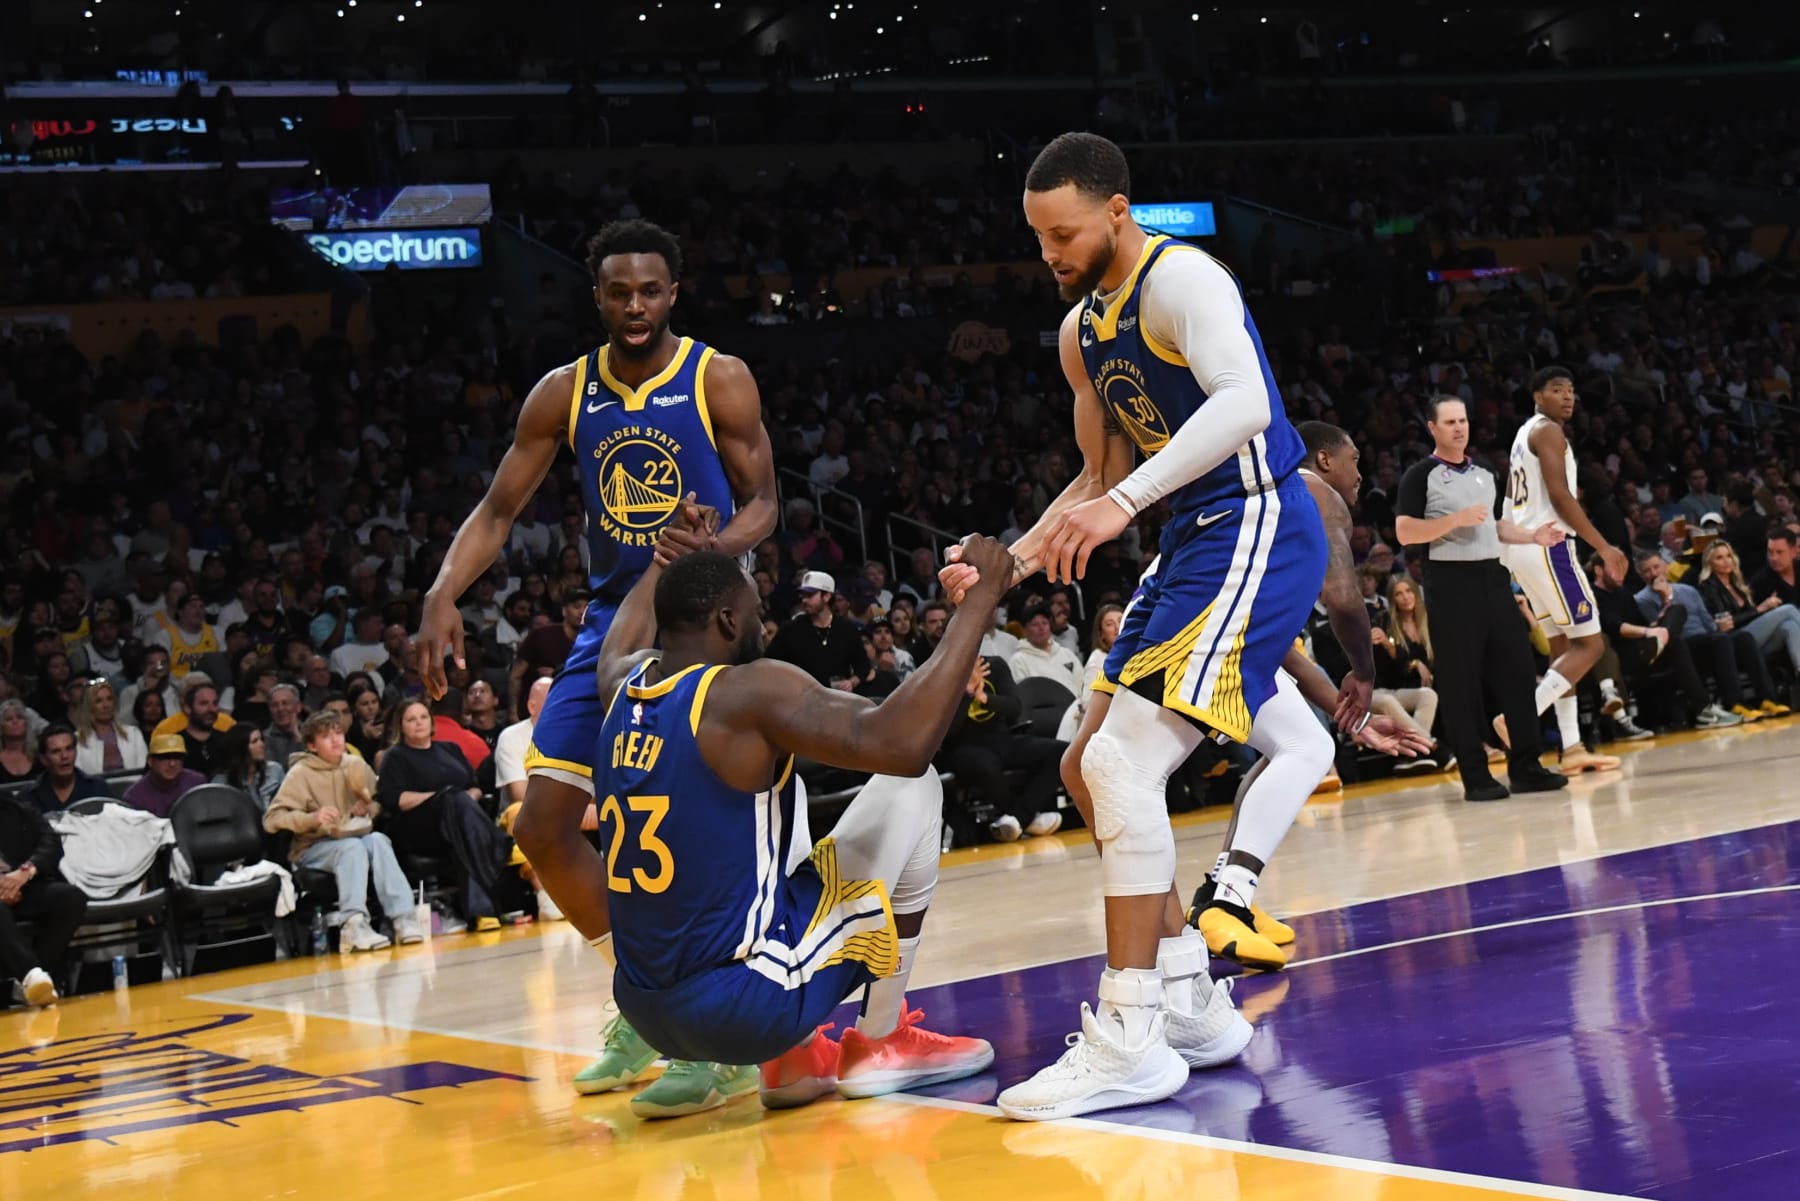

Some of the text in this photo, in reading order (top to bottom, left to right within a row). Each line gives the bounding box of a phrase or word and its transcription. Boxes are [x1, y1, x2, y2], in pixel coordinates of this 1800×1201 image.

[308, 232, 467, 265] Spectrum
[1082, 309, 1090, 325] 6
[587, 381, 598, 395] 6
[1095, 360, 1115, 393] OLDEN
[652, 394, 689, 406] Rakuten
[1128, 396, 1155, 424] 30
[593, 426, 682, 459] GOLDEN STATE
[643, 460, 674, 485] 22
[599, 513, 667, 546] WARRI
[599, 794, 675, 894] 23
